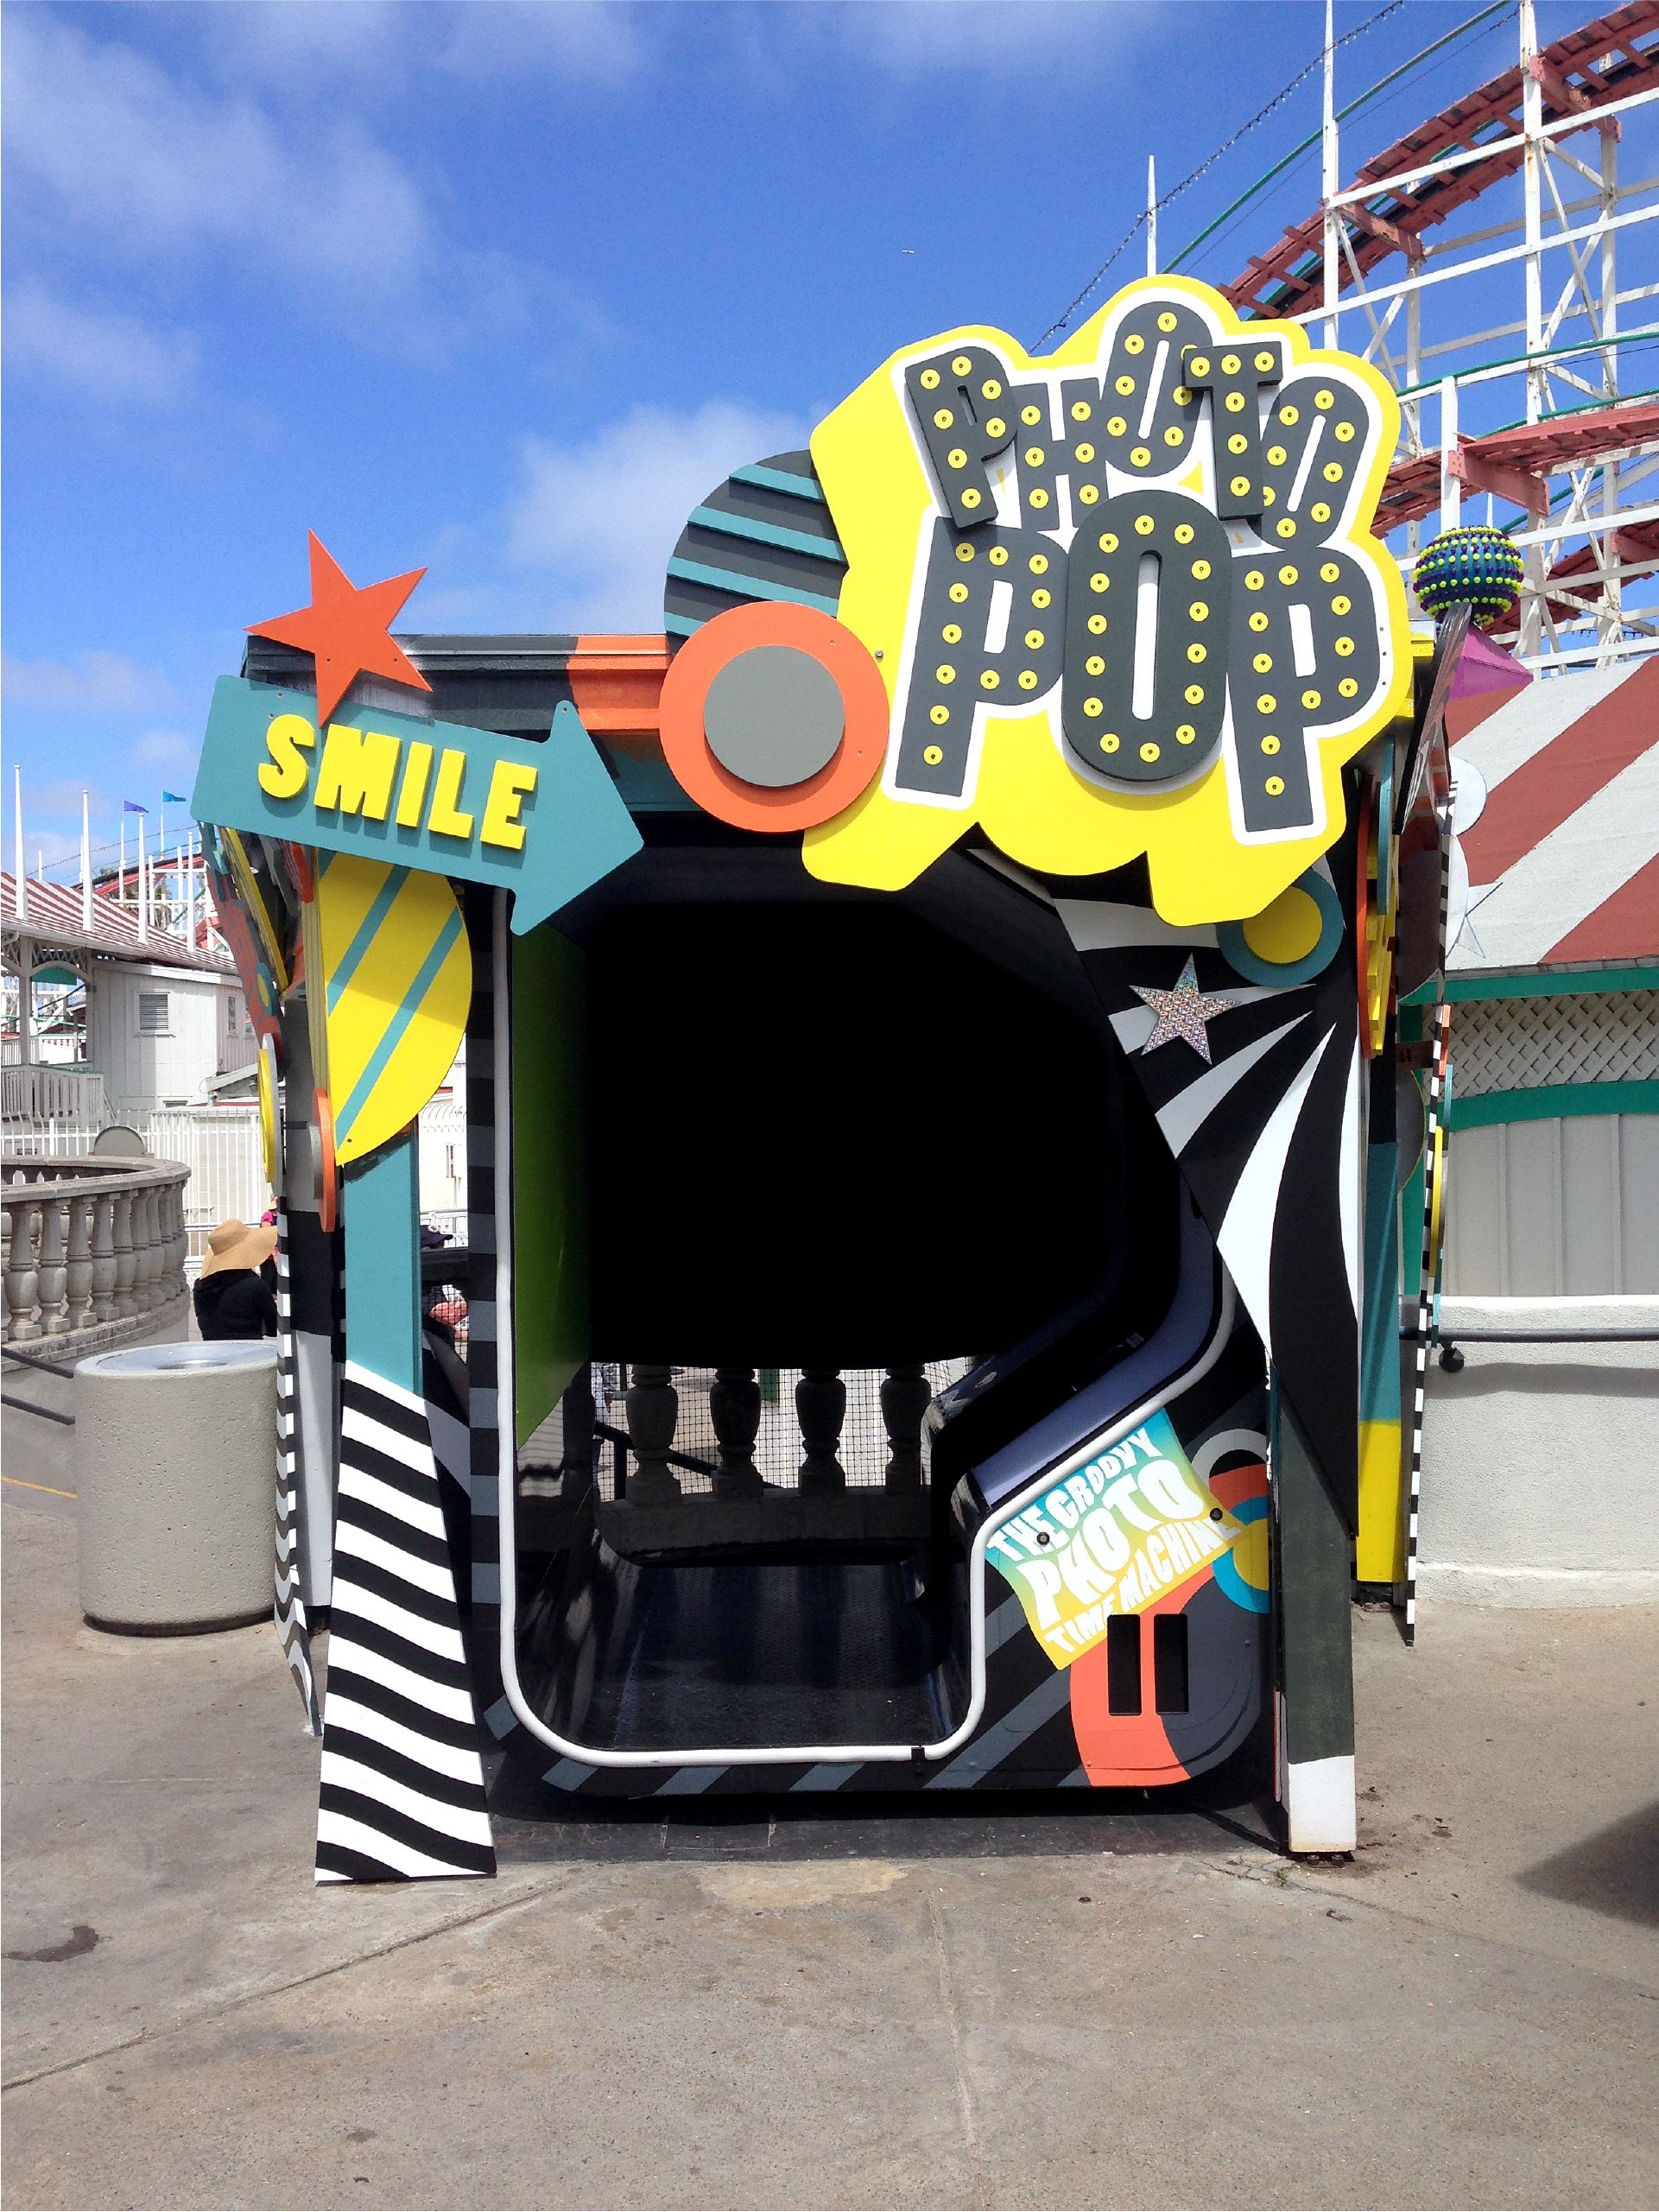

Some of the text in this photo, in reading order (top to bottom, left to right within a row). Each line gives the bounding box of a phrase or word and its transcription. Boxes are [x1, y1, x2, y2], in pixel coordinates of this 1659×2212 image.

[904, 301, 1370, 550] PHOTO
[895, 489, 1381, 833] POP
[257, 713, 539, 851] SMILE
[986, 1428, 1163, 1562] THE GROOVY
[1016, 1459, 1205, 1631] PHOTO
